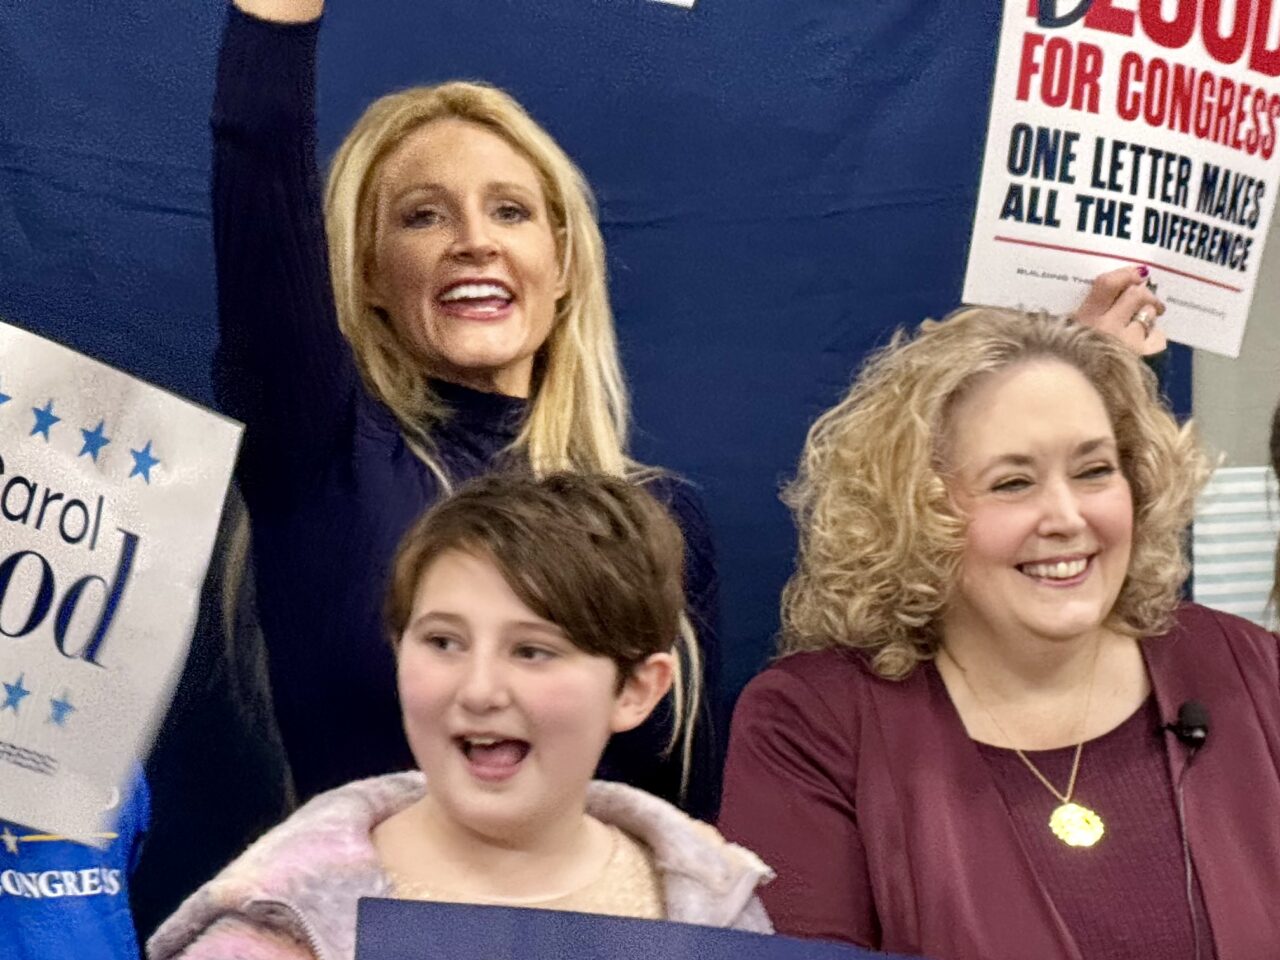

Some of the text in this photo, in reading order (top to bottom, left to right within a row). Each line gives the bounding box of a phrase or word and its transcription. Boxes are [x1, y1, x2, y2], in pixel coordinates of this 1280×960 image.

[1016, 32, 1103, 113] FOR
[1007, 123, 1266, 230] ONE LETTER MAKES
[999, 183, 1254, 271] ALL THE DIFFERENCE
[0, 456, 103, 550] arol
